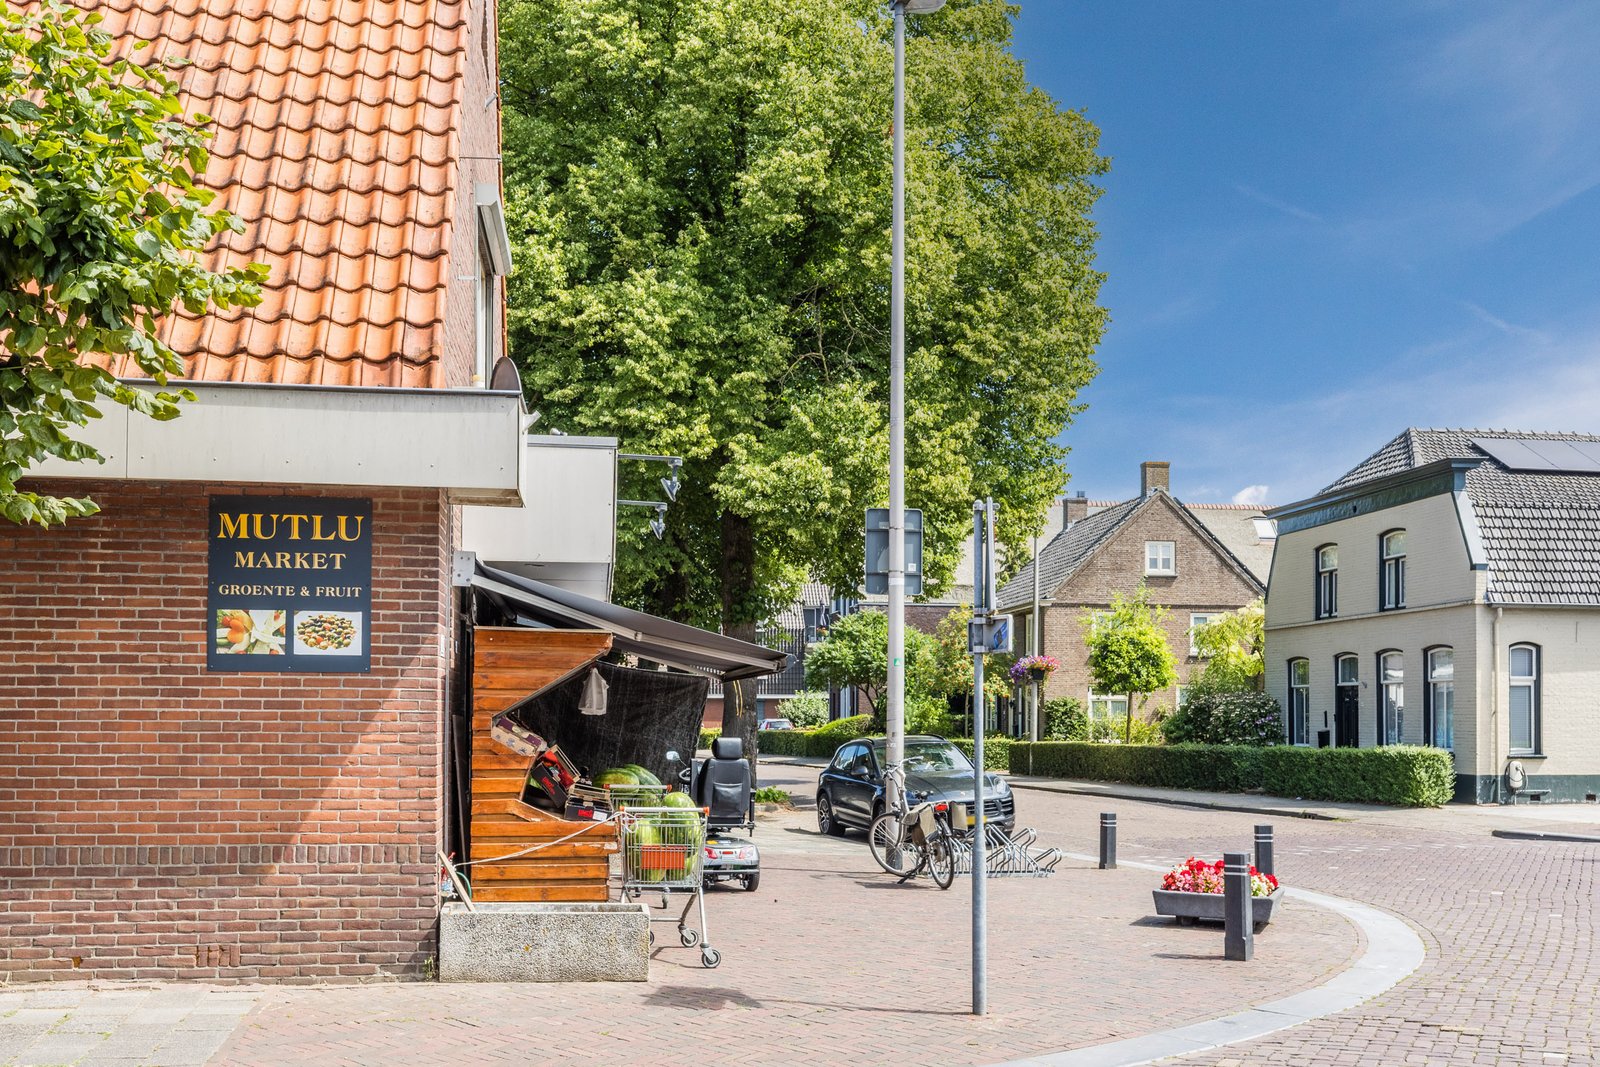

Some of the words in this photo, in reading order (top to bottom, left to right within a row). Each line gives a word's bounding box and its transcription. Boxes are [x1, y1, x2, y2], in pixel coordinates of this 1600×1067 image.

[216, 513, 365, 542] MUTLU
[234, 551, 347, 570] MARKET
[218, 584, 296, 597] GROENTE
[300, 585, 310, 597] &
[315, 586, 362, 598] FRUIT
